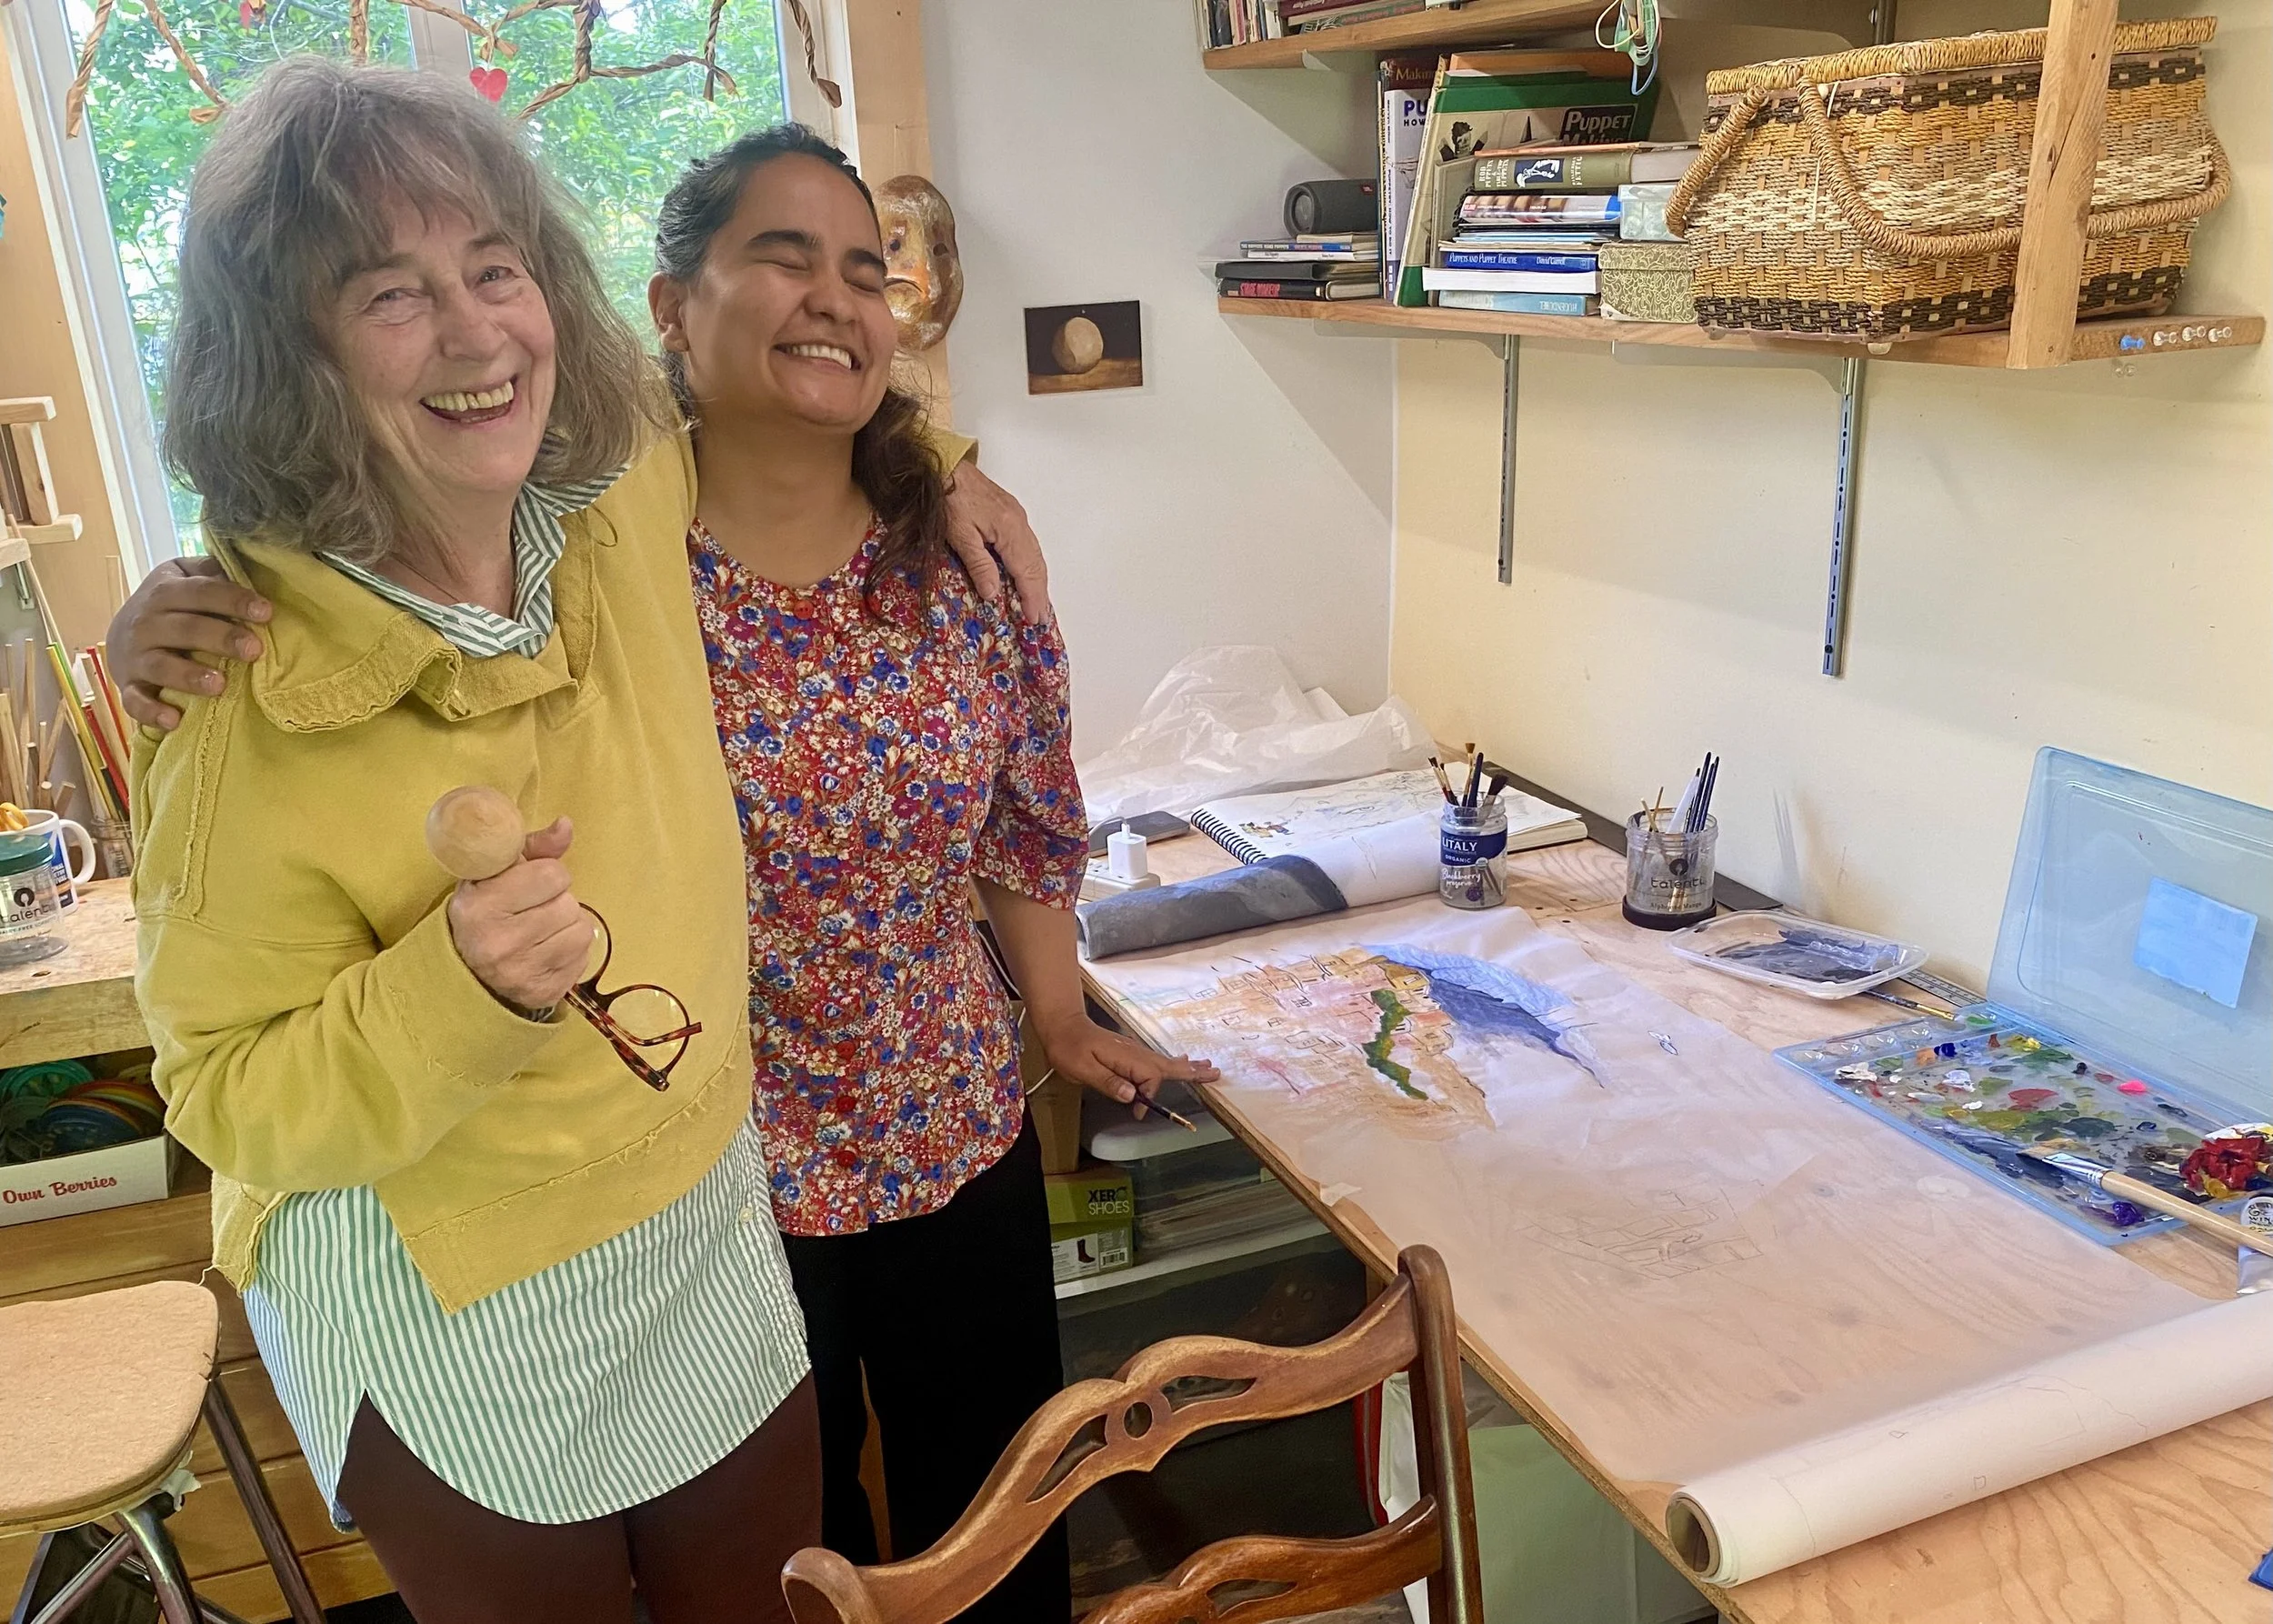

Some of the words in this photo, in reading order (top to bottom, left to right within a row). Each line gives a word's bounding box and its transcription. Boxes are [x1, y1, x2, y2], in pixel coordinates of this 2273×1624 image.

[1445, 854, 1471, 863] ORGANIC
[1650, 876, 1705, 889] talenti
[3, 1189, 45, 1204] Own
[48, 1177, 117, 1197] Berries
[1088, 1200, 1130, 1216] SHOES
